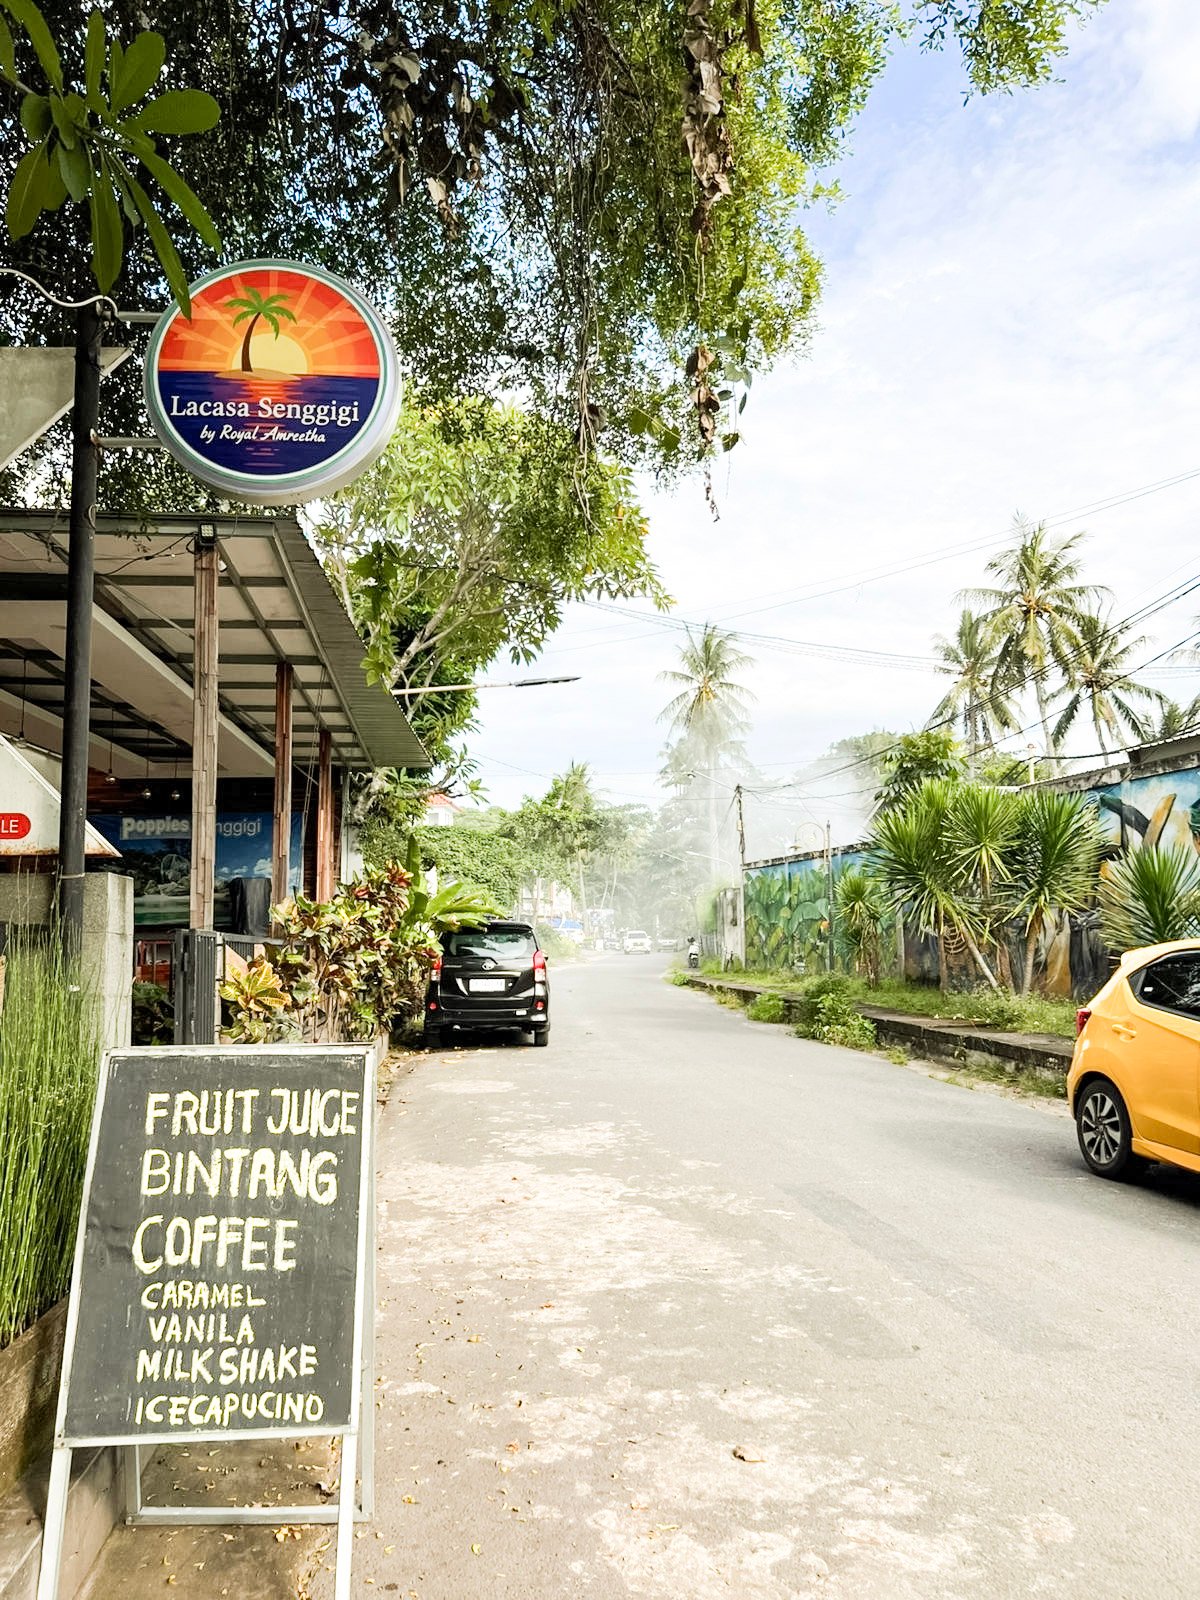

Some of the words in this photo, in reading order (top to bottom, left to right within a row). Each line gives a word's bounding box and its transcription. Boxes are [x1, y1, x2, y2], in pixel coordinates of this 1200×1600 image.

[170, 395, 250, 418] Lacasa
[257, 396, 360, 427] Senggigi
[199, 424, 216, 444] by
[219, 424, 259, 445] Royal
[260, 425, 326, 443] Amreetha
[122, 815, 190, 841] Poppies
[215, 817, 263, 837] nggigi
[144, 1088, 261, 1137] FRUIT
[266, 1087, 361, 1138] JUICE
[140, 1147, 338, 1206] BINTANG
[131, 1214, 299, 1275] COFFEE
[140, 1279, 267, 1310] CARAMEL
[148, 1313, 256, 1346] VANILA
